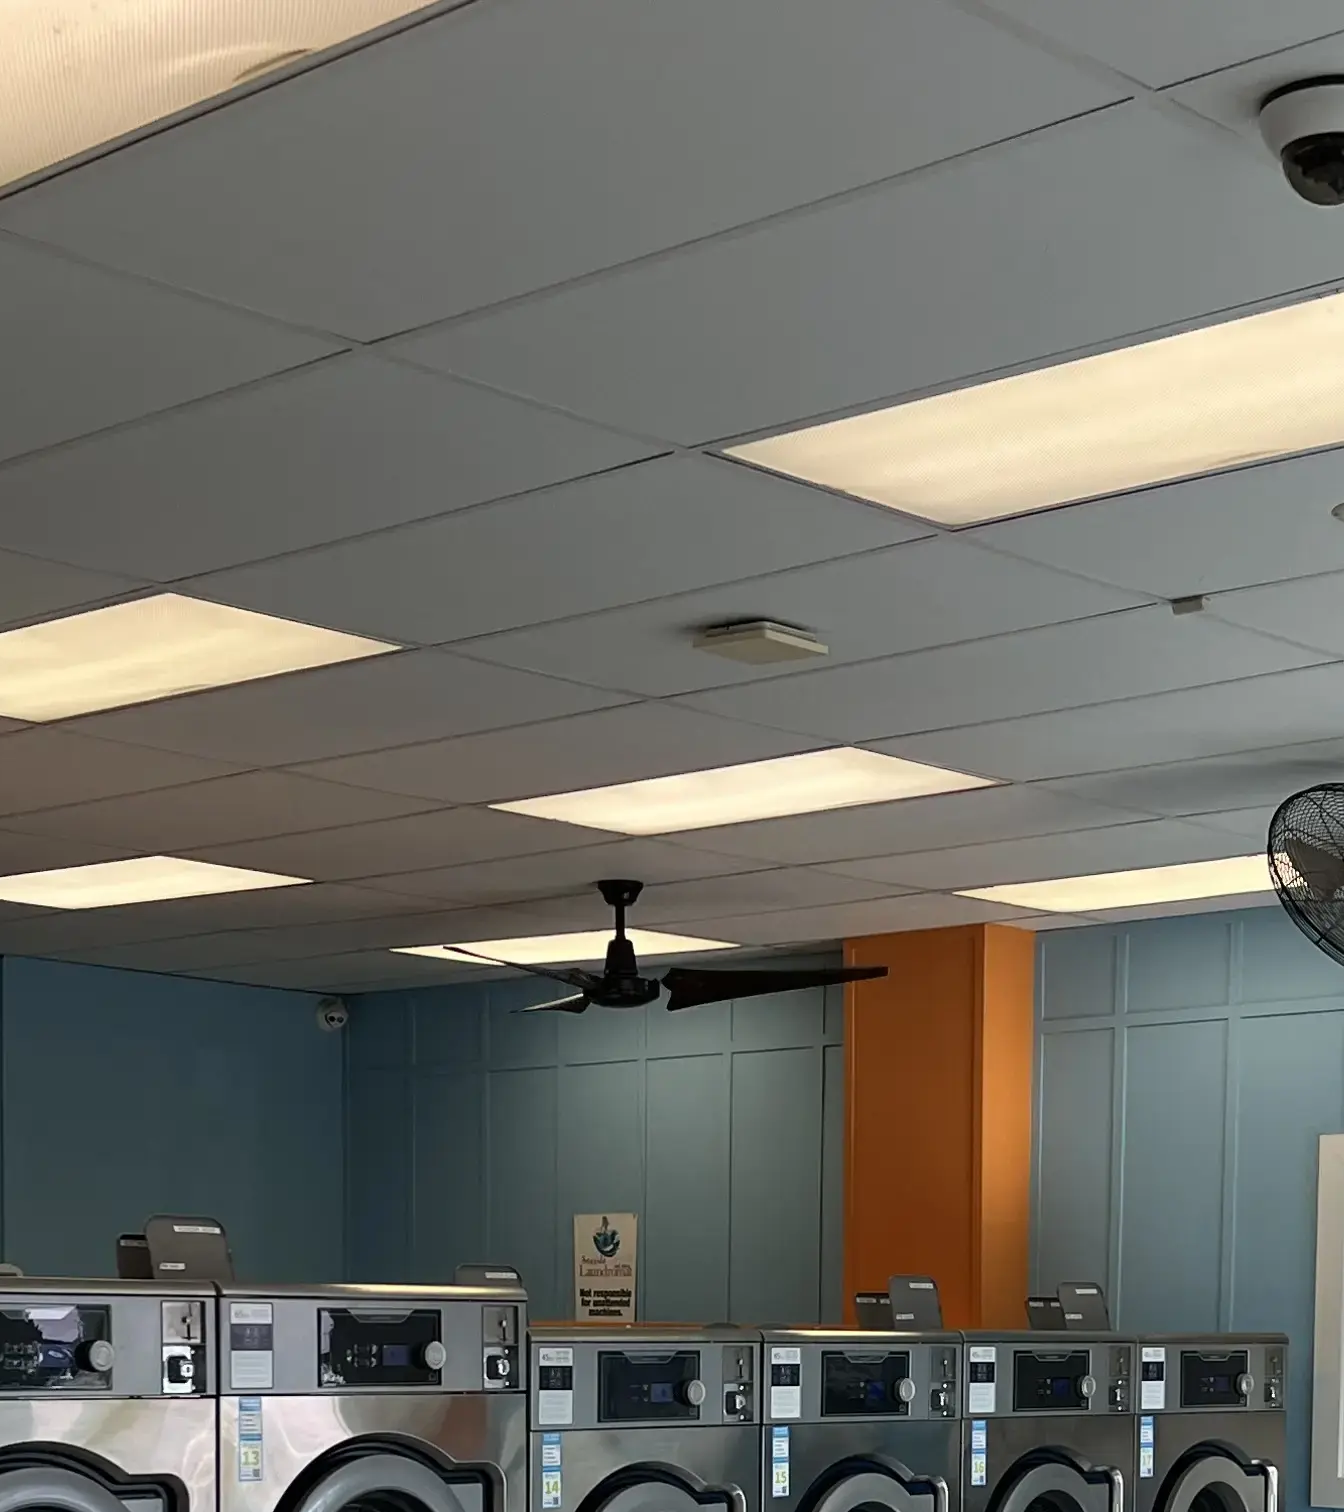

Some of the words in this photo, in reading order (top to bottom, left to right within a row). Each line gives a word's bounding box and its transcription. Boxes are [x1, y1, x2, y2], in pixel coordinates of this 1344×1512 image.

[242, 1451, 260, 1466] 13
[973, 1461, 984, 1473] 16
[775, 1471, 787, 1484] 15
[545, 1480, 560, 1495] 14
